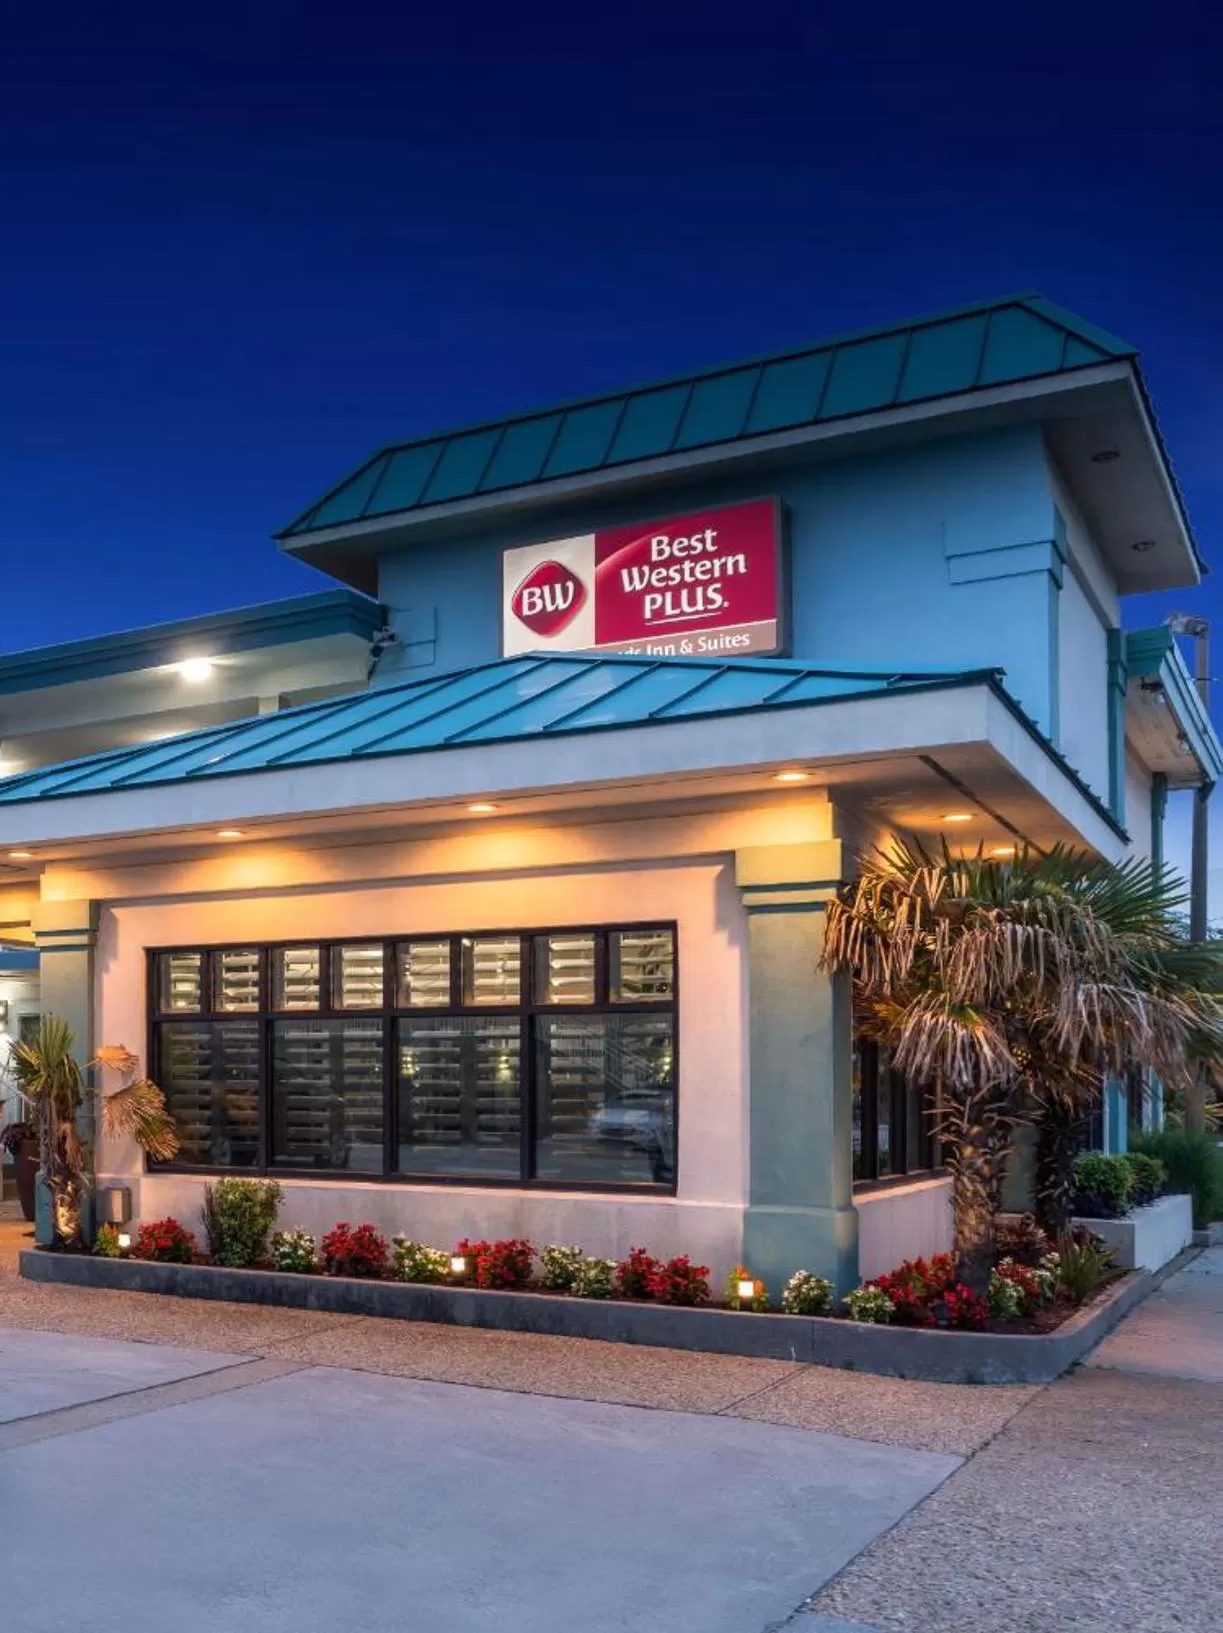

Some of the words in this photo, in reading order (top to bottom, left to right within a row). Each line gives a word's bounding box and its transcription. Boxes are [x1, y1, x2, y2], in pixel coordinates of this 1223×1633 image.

[651, 529, 718, 562] Best
[620, 553, 747, 593] Western
[522, 580, 574, 616] BW
[647, 643, 675, 656] Inn
[680, 638, 693, 654] &
[697, 632, 750, 652] Suites
